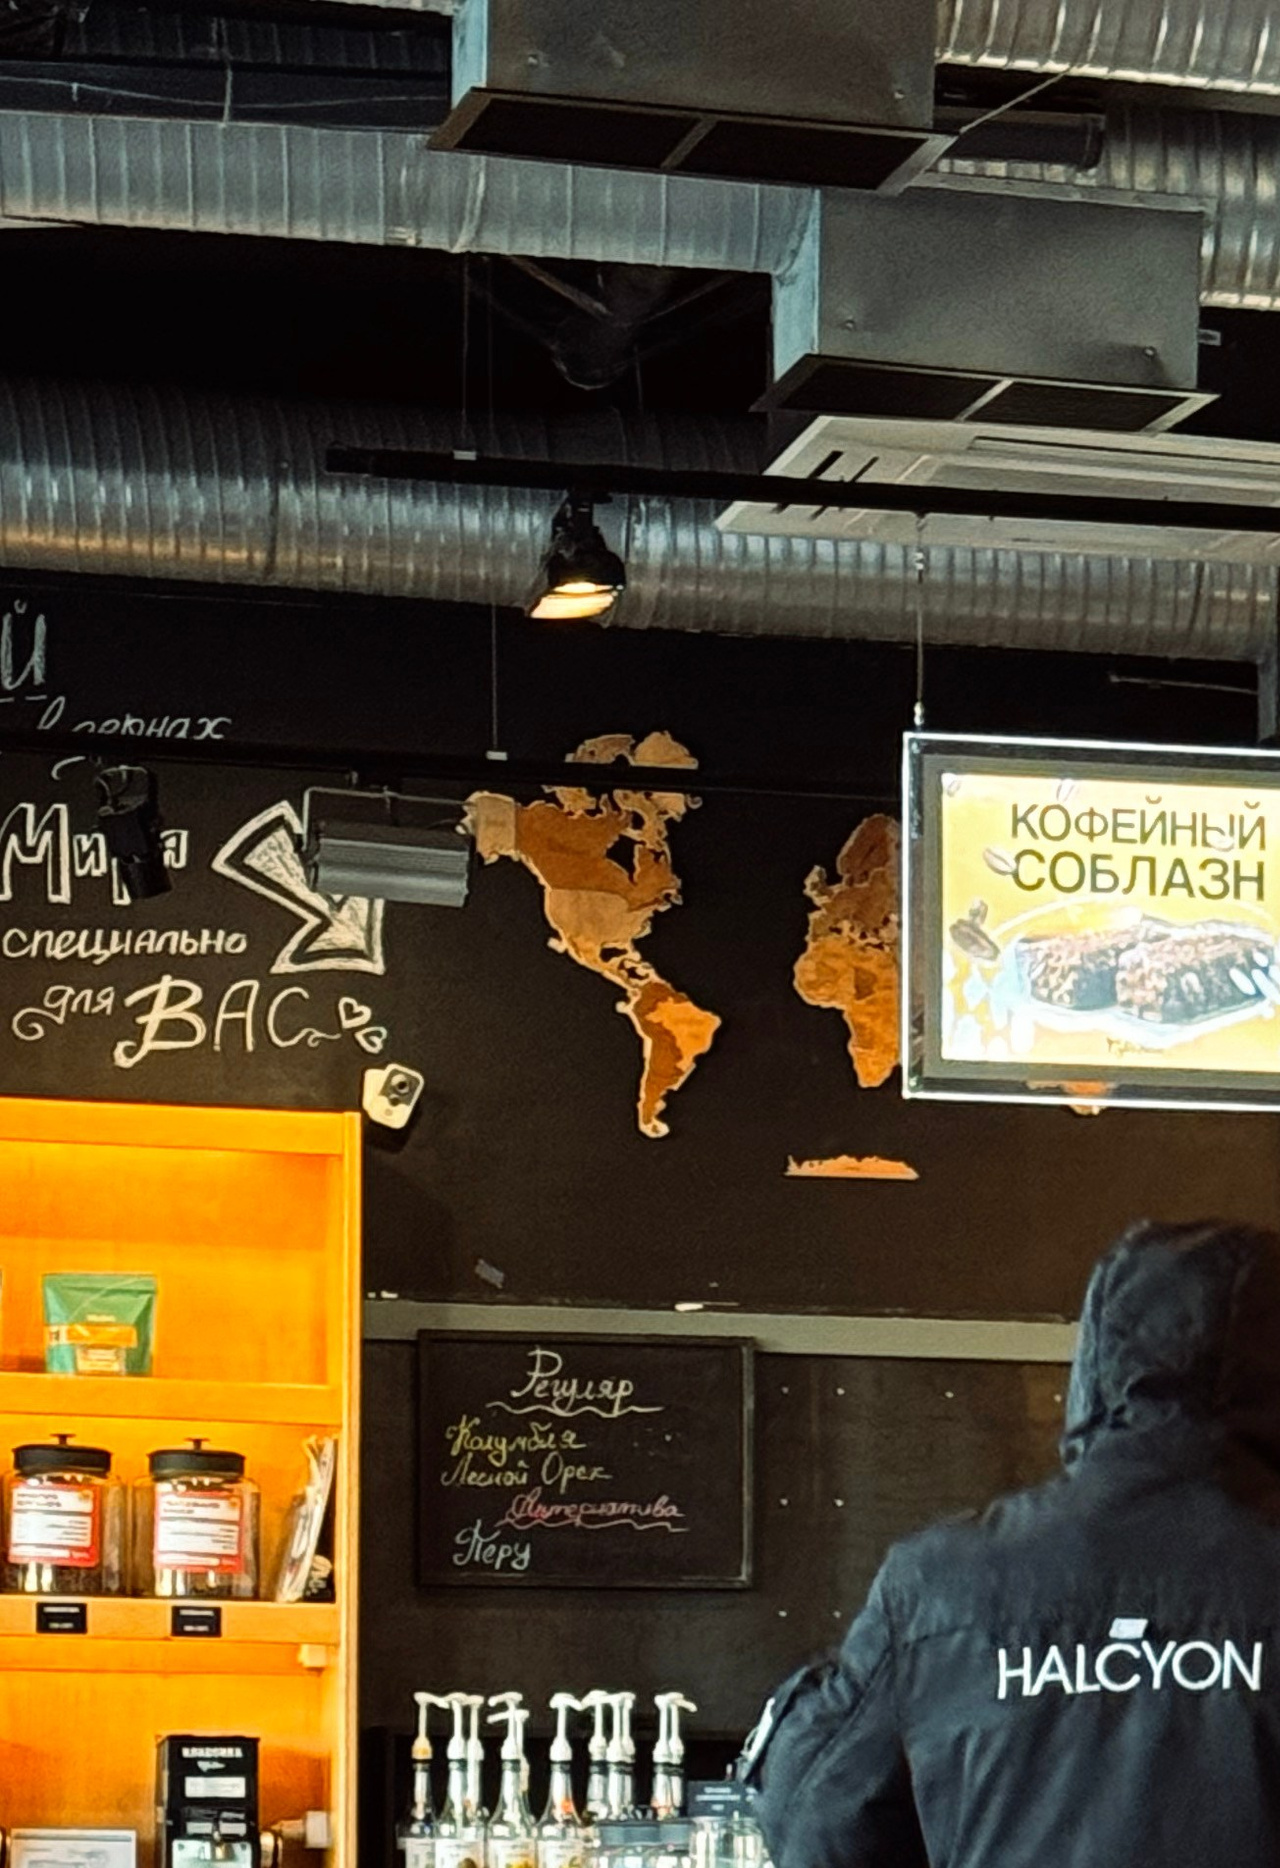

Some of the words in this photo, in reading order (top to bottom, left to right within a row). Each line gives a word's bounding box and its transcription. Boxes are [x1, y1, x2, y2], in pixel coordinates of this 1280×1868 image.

[1011, 795, 1266, 852] КОФЕЙНЫЙ
[1013, 848, 1265, 901] СОБЛАЗН
[2, 928, 248, 965] специально
[20, 984, 116, 1038] для
[112, 974, 325, 1068] ВАС
[510, 1344, 634, 1418] Регуляр
[445, 1413, 588, 1468] Колумбия
[438, 1451, 530, 1488] Лесной
[452, 1518, 531, 1571] Перу
[997, 1639, 1263, 1700] HALCYON
